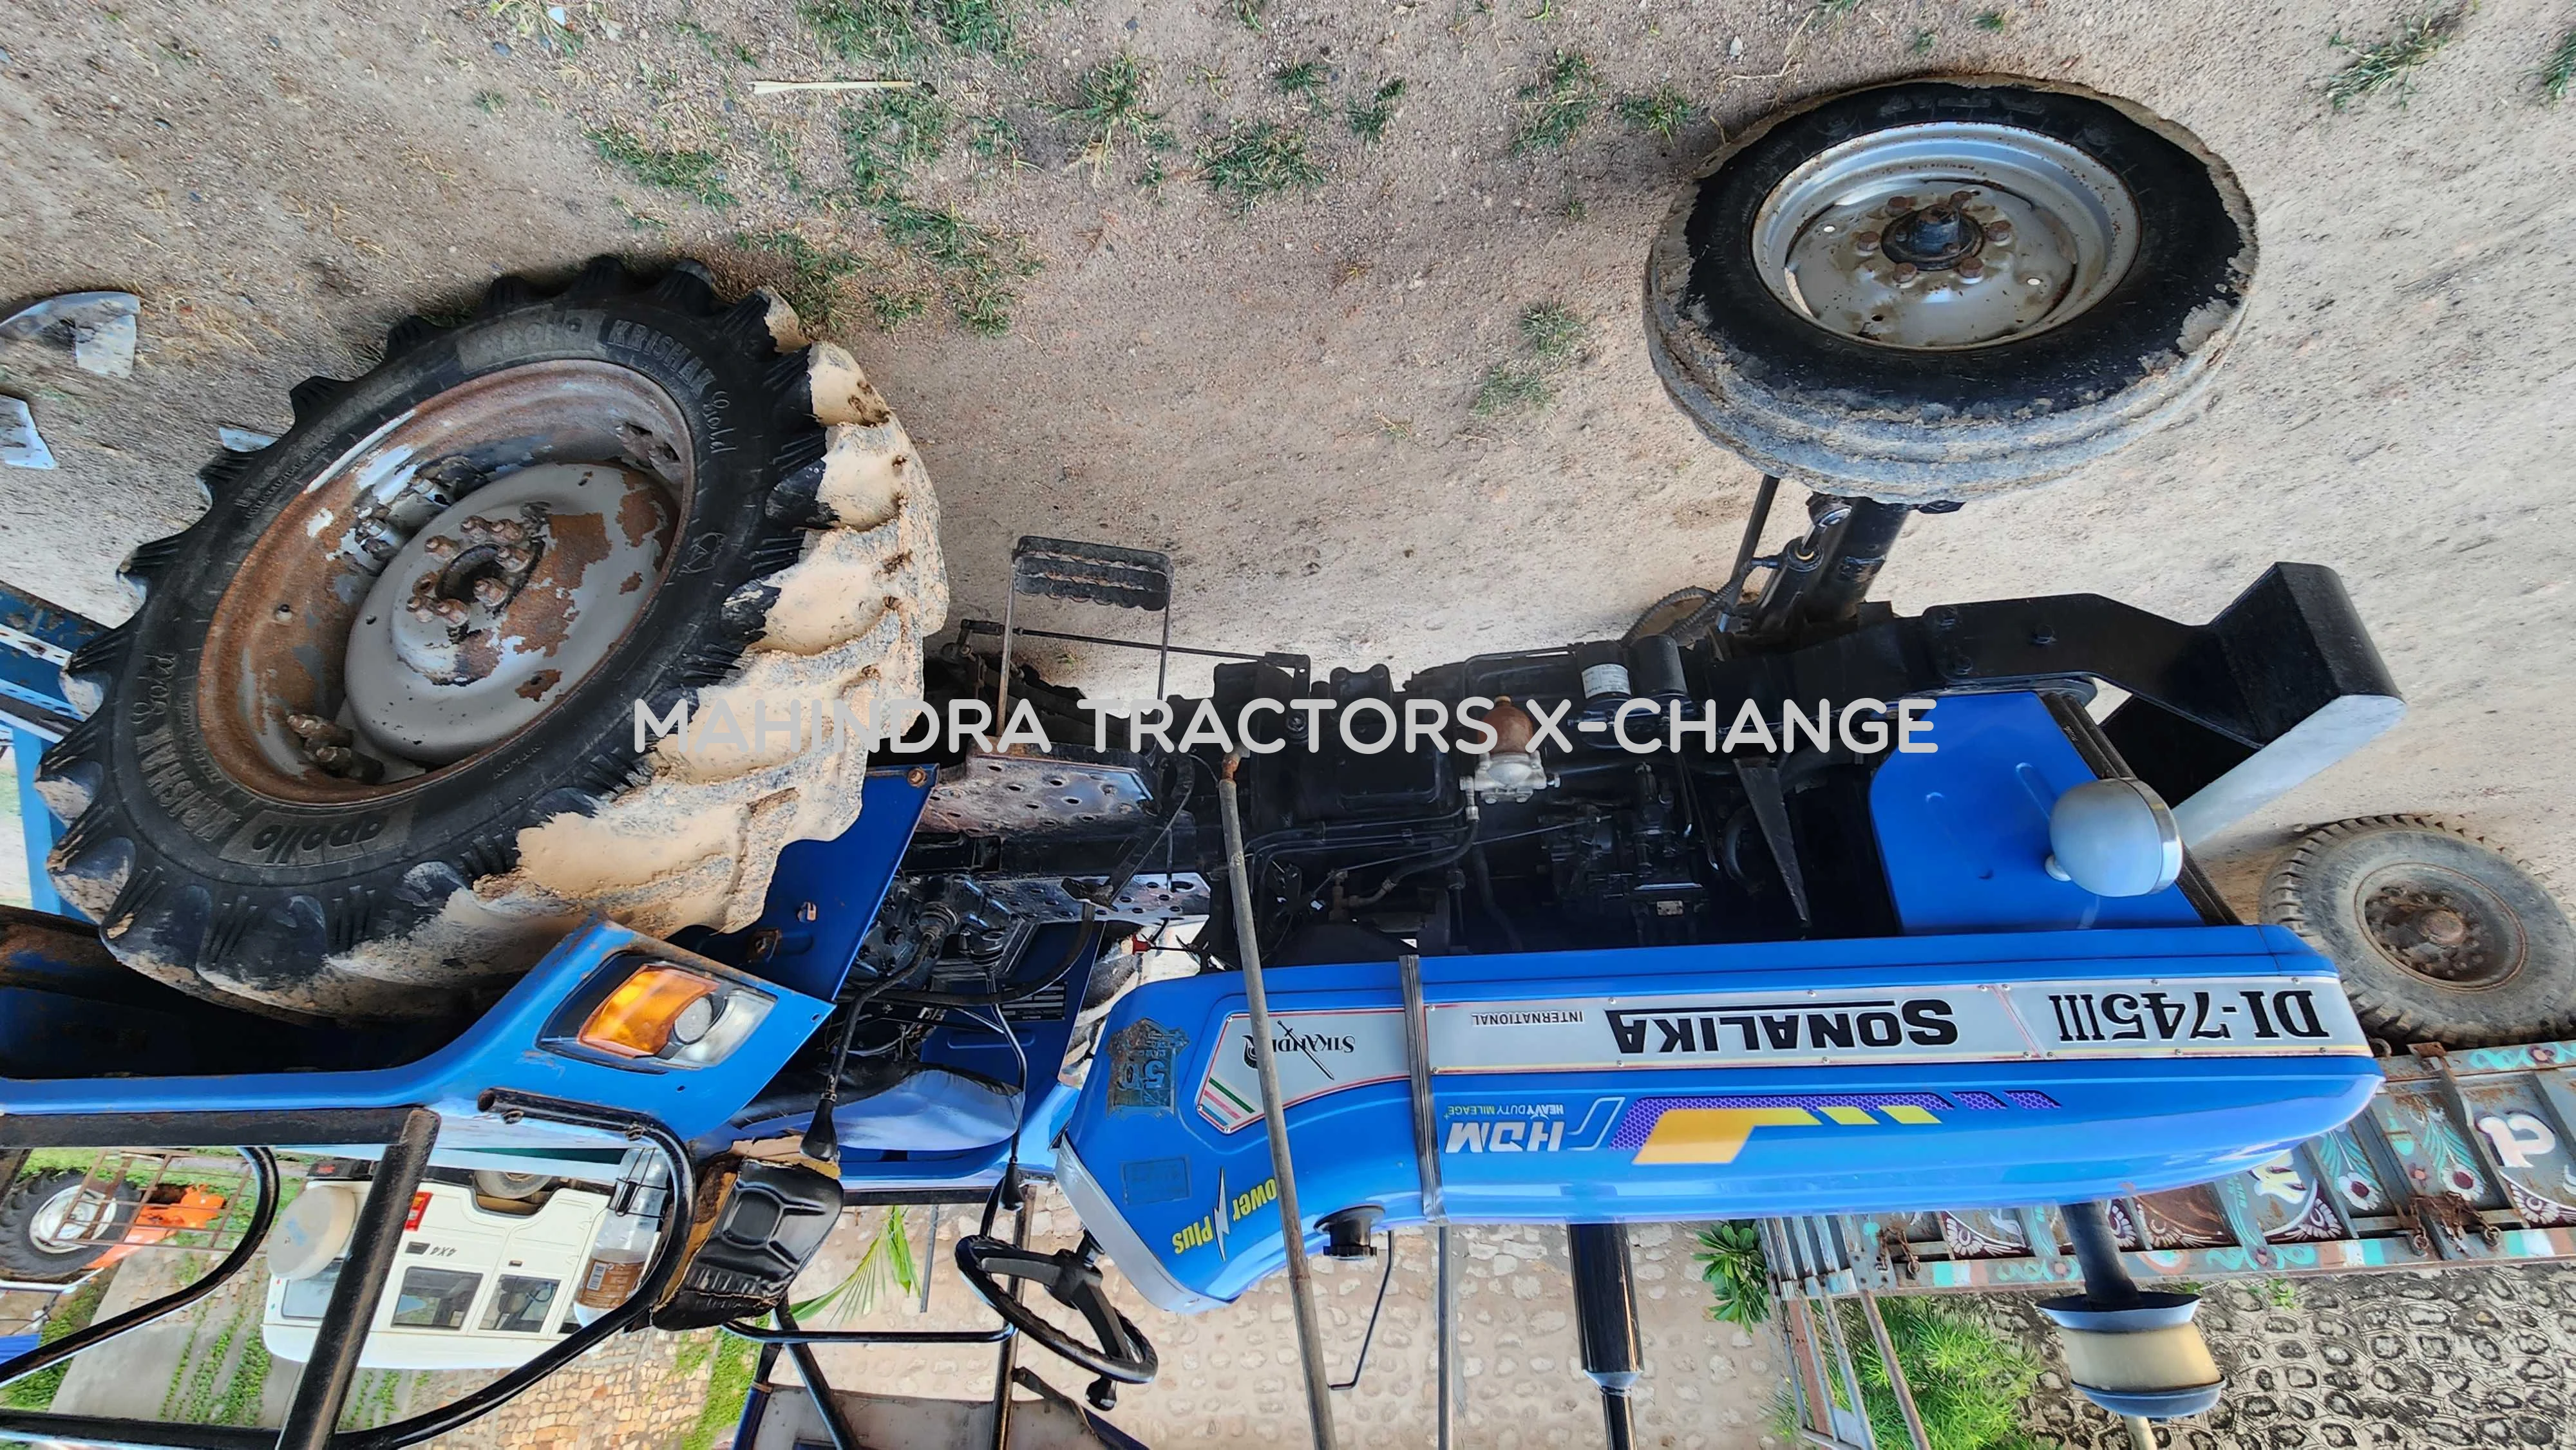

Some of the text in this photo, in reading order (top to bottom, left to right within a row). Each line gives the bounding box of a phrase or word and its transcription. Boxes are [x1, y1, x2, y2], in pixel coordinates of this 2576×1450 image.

[608, 319, 717, 399] KRISHAK
[703, 390, 738, 453] Gold
[135, 726, 243, 842] KRISHAK
[251, 820, 387, 864] apollo
[1471, 1012, 1584, 1026] INTERNATIONAL
[1604, 999, 1959, 1057] SONALIKA
[1495, 1104, 1526, 1116] DUTY
[1527, 1104, 1565, 1118] HEAVY
[1445, 1121, 1566, 1154] HDM
[1171, 1178, 1278, 1255] ower Plus
